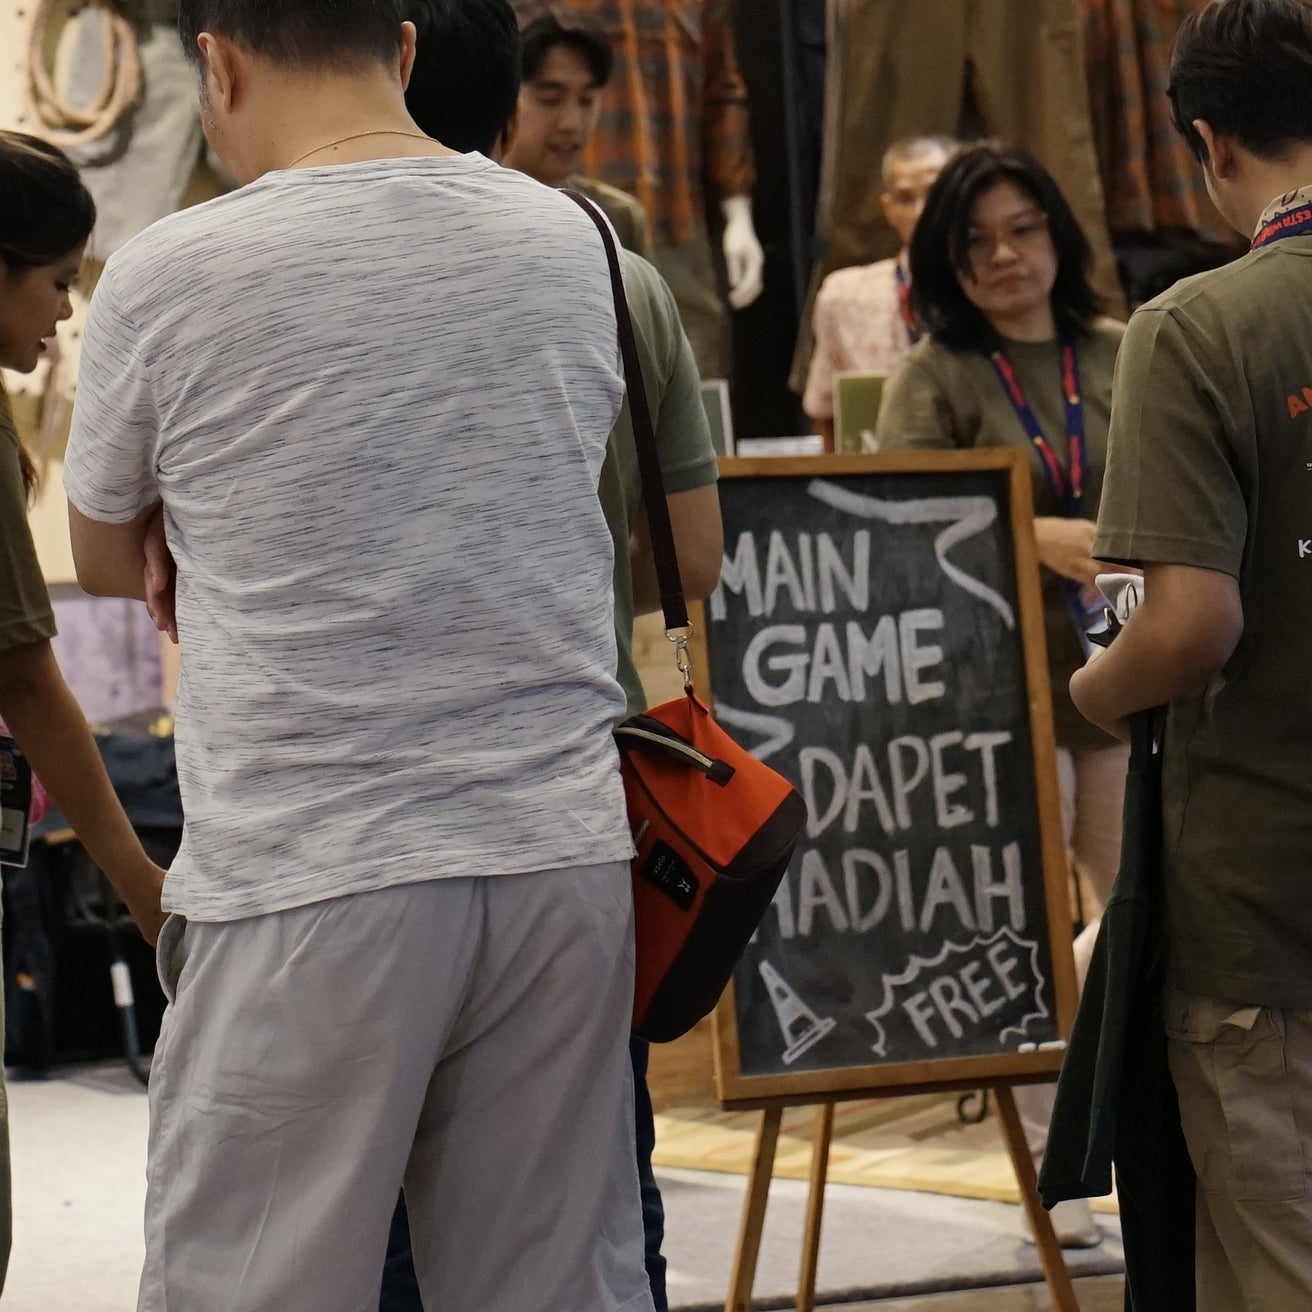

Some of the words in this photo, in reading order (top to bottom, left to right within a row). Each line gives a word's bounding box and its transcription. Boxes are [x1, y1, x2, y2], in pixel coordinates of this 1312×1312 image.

[710, 530, 871, 621] MAIN
[742, 608, 946, 708] GAME
[799, 730, 1012, 839] DAPET
[902, 941, 1028, 1048] FREE
